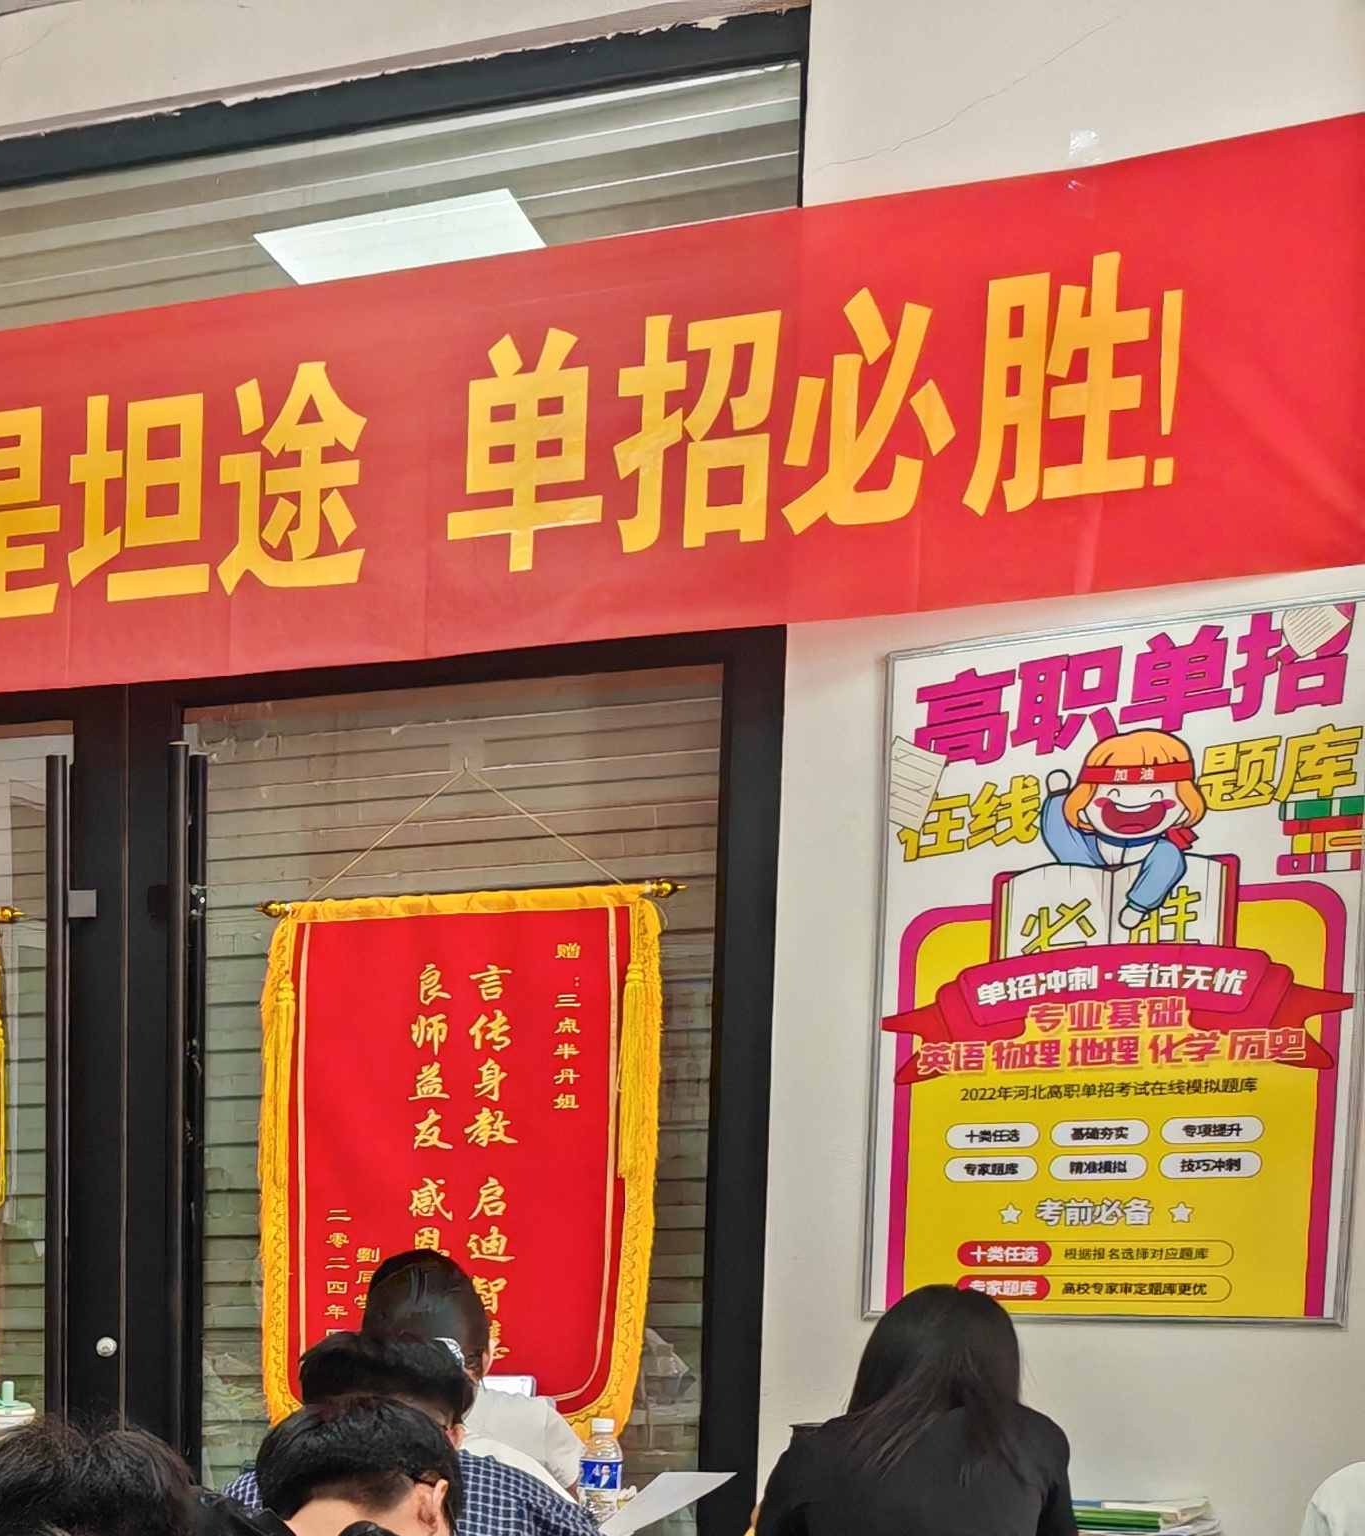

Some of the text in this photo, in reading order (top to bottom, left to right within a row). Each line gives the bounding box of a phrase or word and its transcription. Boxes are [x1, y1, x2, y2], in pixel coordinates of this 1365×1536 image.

[914, 602, 1355, 767] 高职单招
[1114, 768, 1155, 782] 加油
[1197, 724, 1364, 812] 题库
[1027, 996, 1189, 1033] 专业基础
[408, 963, 453, 1151] 良师益友
[463, 963, 518, 1149] 言传身教
[916, 1027, 1306, 1076] 英语 物理 地理 化学 历史
[1035, 1198, 1153, 1226] 考前必备
[324, 1209, 352, 1336] 二零二四年
[969, 1245, 1039, 1263] 十类任选
